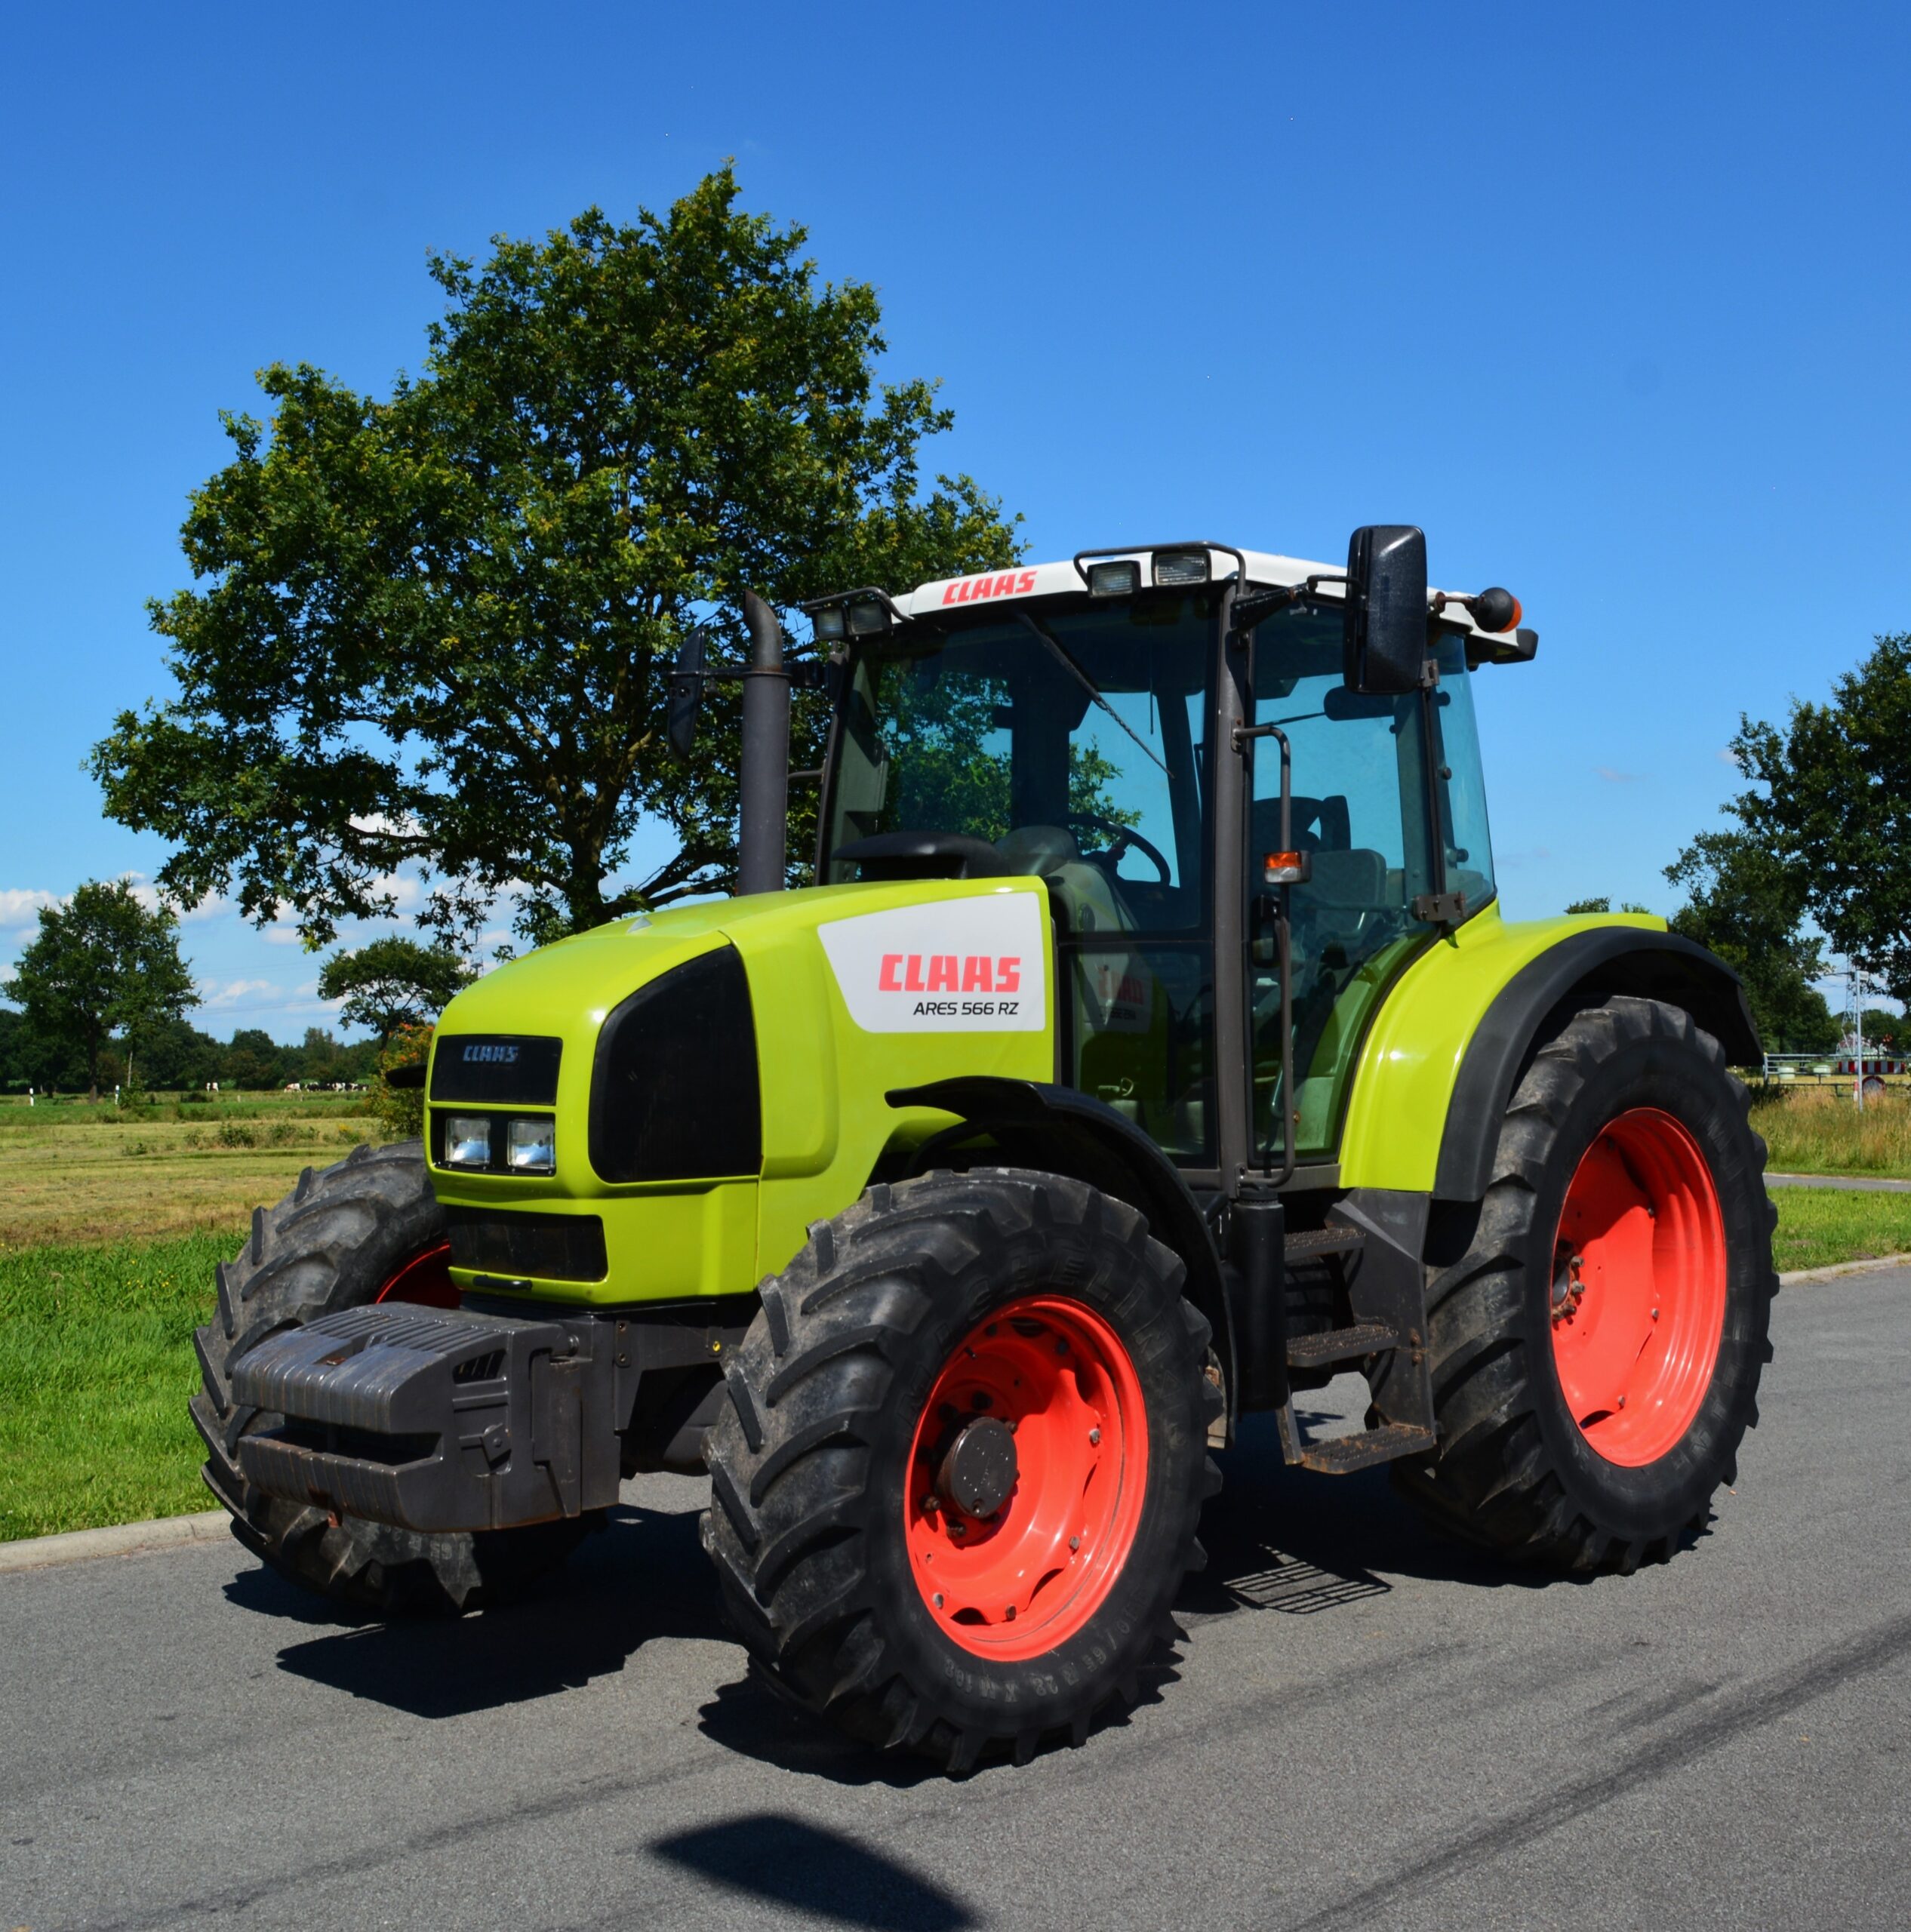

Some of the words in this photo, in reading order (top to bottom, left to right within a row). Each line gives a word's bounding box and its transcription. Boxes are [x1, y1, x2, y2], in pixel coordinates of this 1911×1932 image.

[942, 571, 1038, 605] CLAAS
[879, 954, 1021, 992] CLAAS
[913, 1002, 957, 1016] ARES
[962, 1002, 995, 1016] 566
[998, 1002, 1020, 1016] RZ
[463, 1045, 519, 1062] CLAAS
